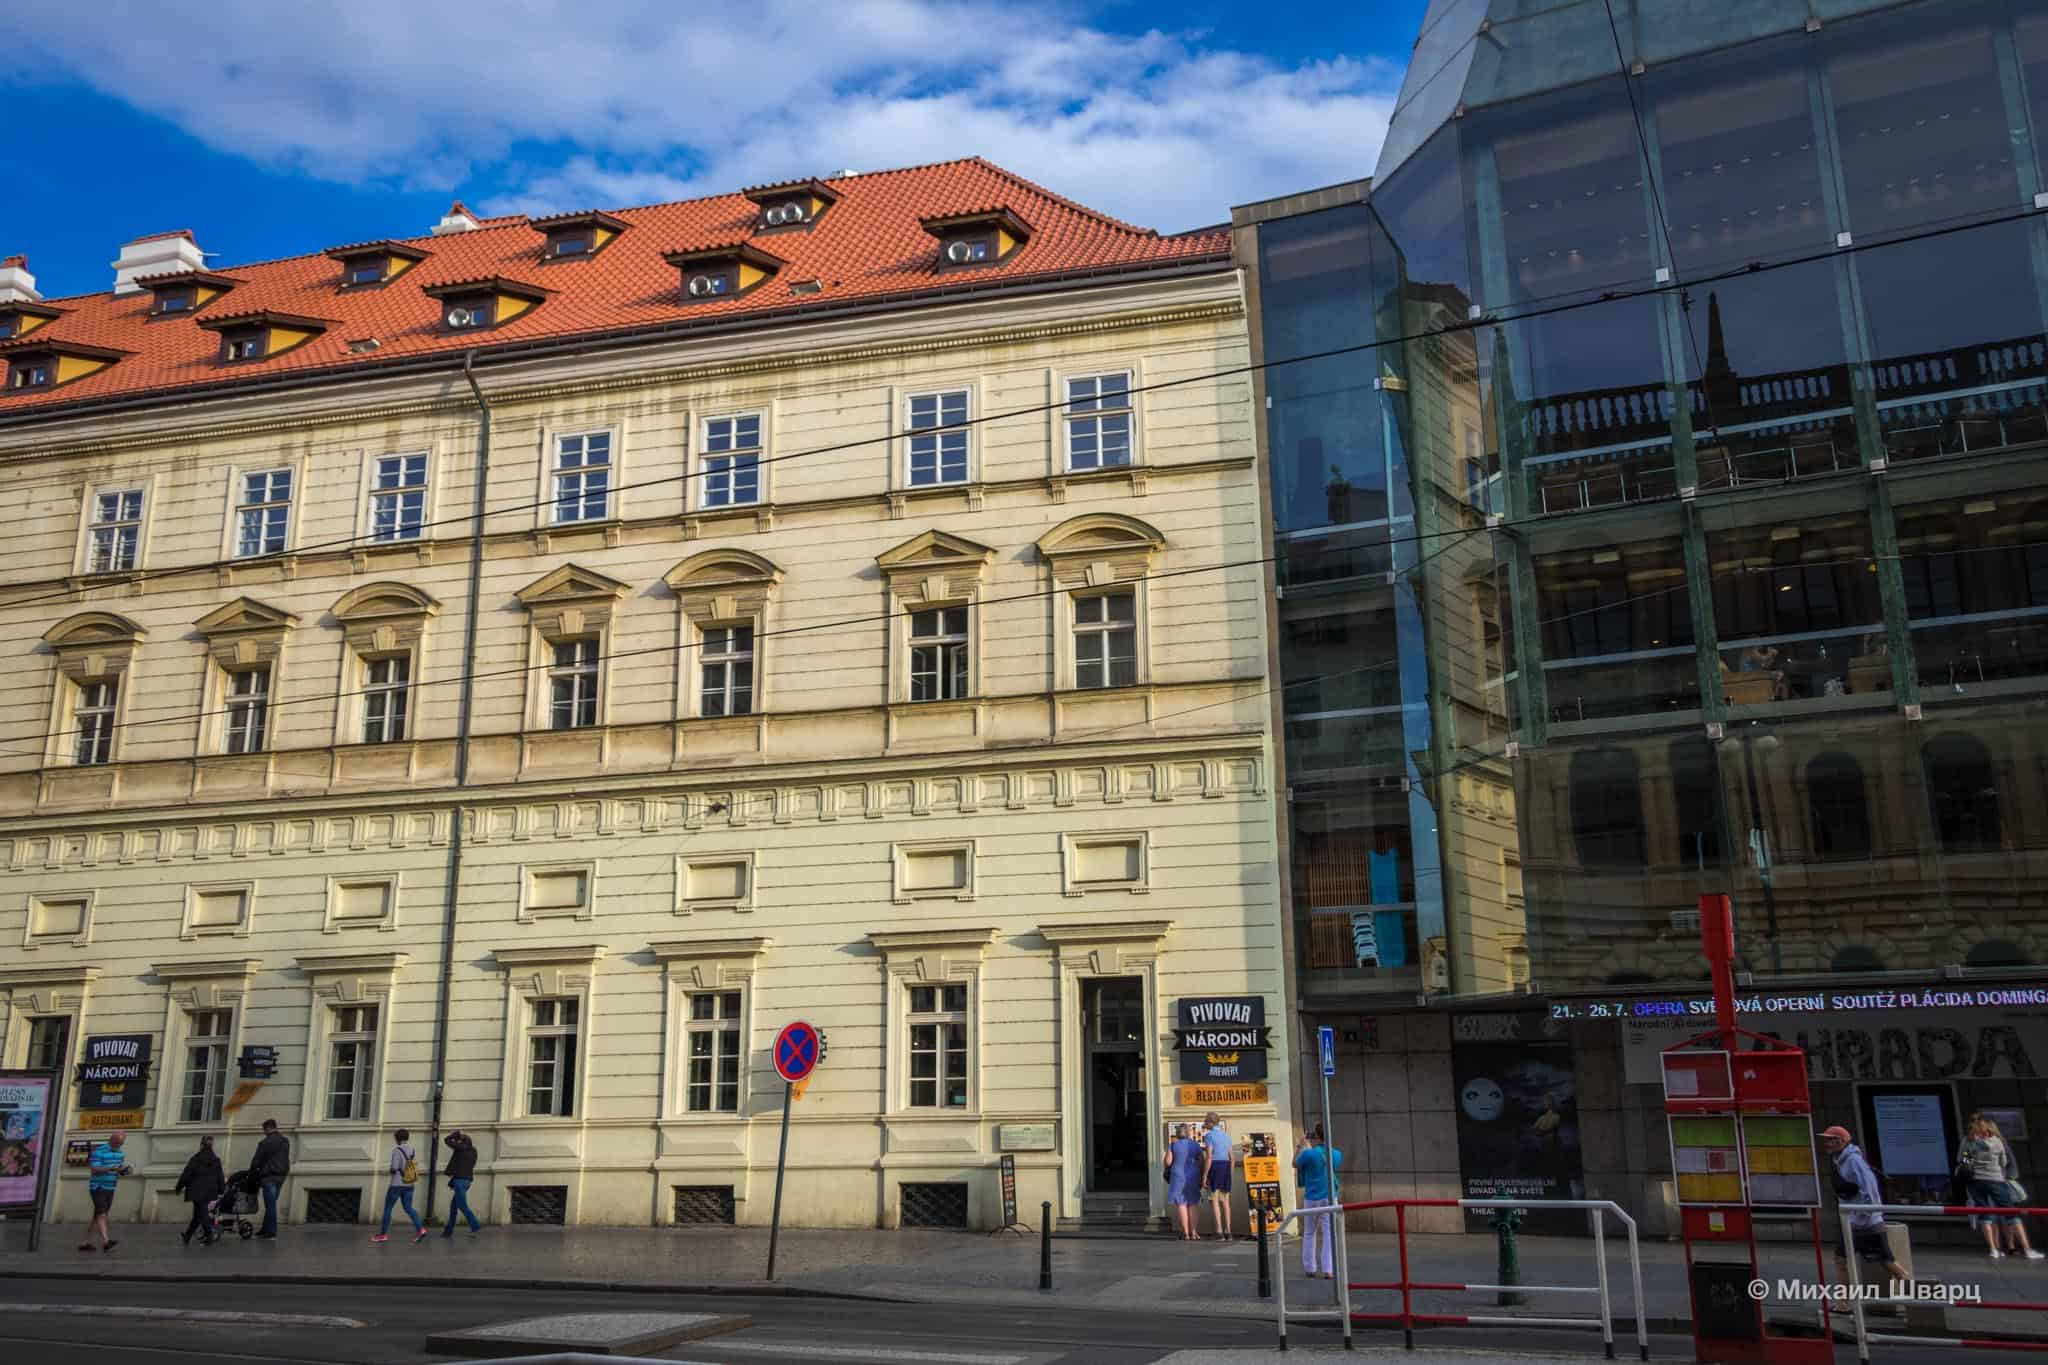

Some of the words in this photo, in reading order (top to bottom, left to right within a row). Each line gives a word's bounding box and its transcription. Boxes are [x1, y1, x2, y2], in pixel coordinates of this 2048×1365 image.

[1633, 1001, 1685, 1015] OPERA
[1689, 995, 1762, 1015] SVĚOVÁ
[1765, 992, 1824, 1012] OPERNÍ
[1832, 991, 1896, 1009] SOUTĚŽ
[1900, 988, 1973, 1008] PLÁCIDA
[1977, 989, 2048, 1006] DOMING
[1190, 1002, 1251, 1024] PIVOVAR
[1185, 1029, 1257, 1047] NÁRODNÍ
[93, 1040, 139, 1058] PIVOVAR
[85, 1063, 139, 1079] NÁRODNÍ
[1196, 1088, 1251, 1103] RESTAURANT
